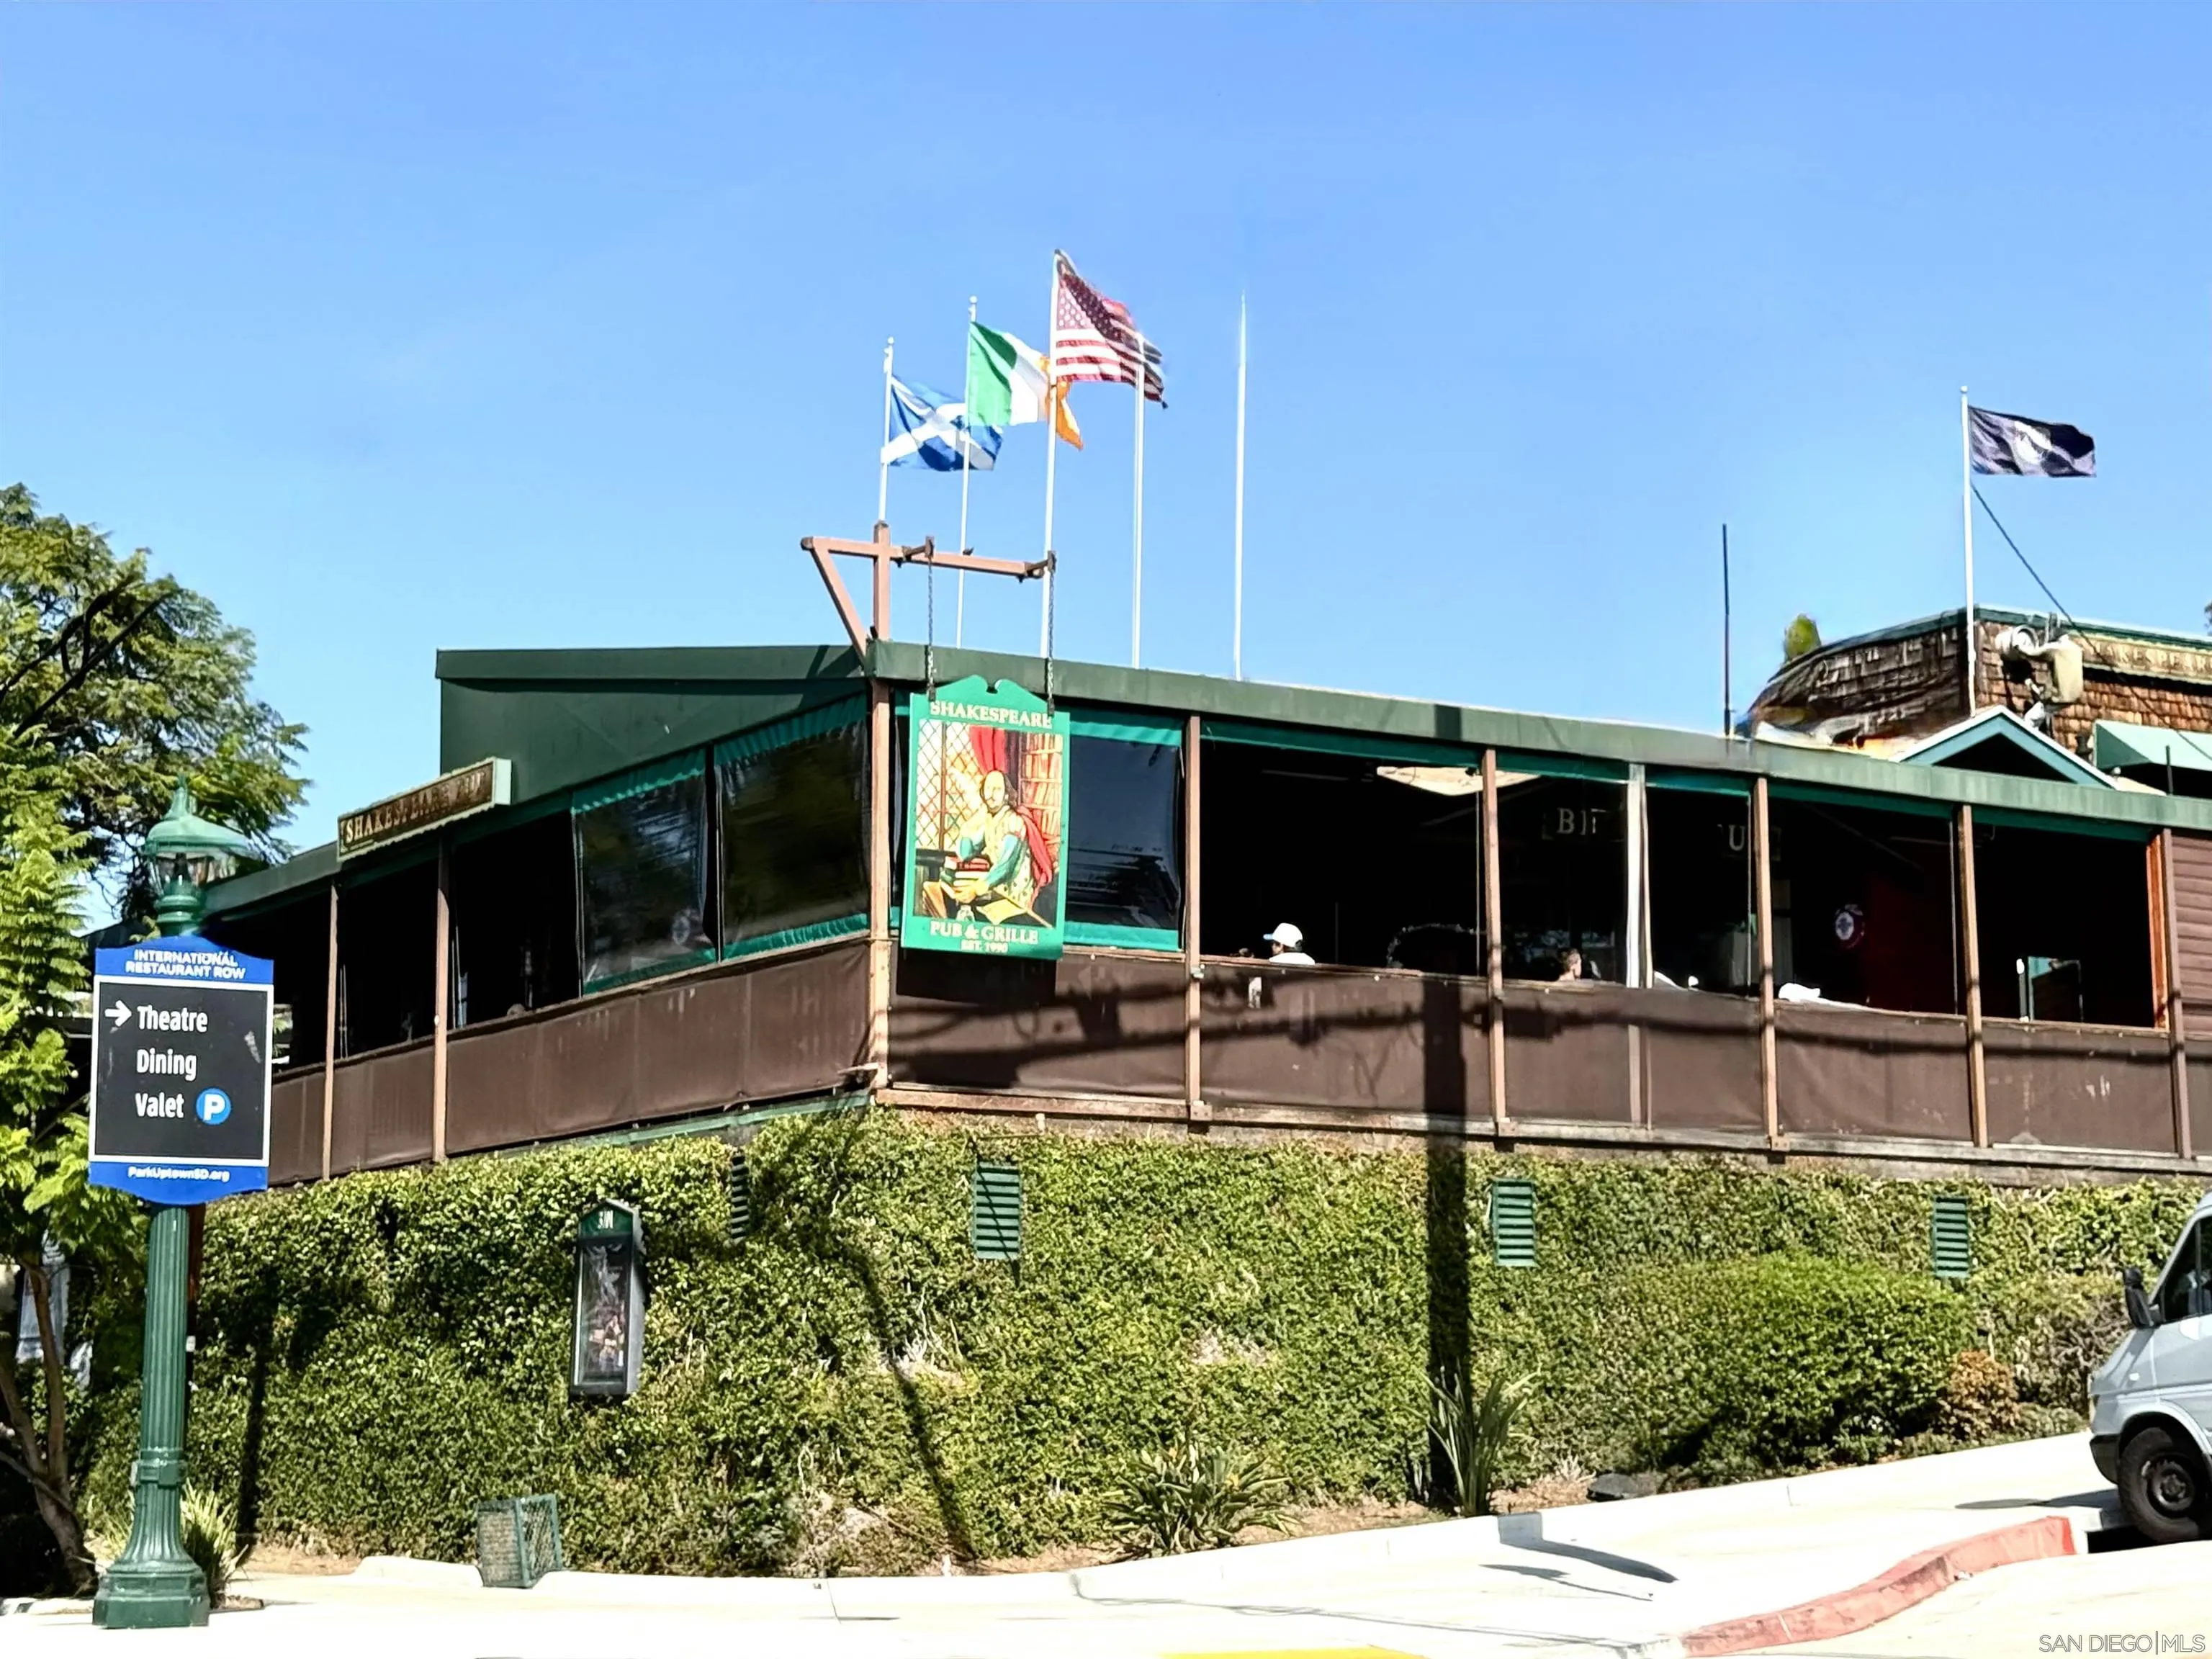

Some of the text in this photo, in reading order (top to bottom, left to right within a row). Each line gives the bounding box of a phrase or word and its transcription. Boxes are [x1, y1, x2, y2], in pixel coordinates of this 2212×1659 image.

[930, 700, 1053, 729] SHAKESPEARE
[930, 920, 1039, 945] PUB & GRILLE
[125, 961, 246, 979] RESTAURANT ROW
[134, 949, 238, 967] INTERNATIONAL
[137, 1004, 208, 1033] Theatre
[136, 1048, 197, 1082] Dining
[135, 1092, 226, 1121] Valet P
[127, 1165, 230, 1183] ParkUptownSD.org
